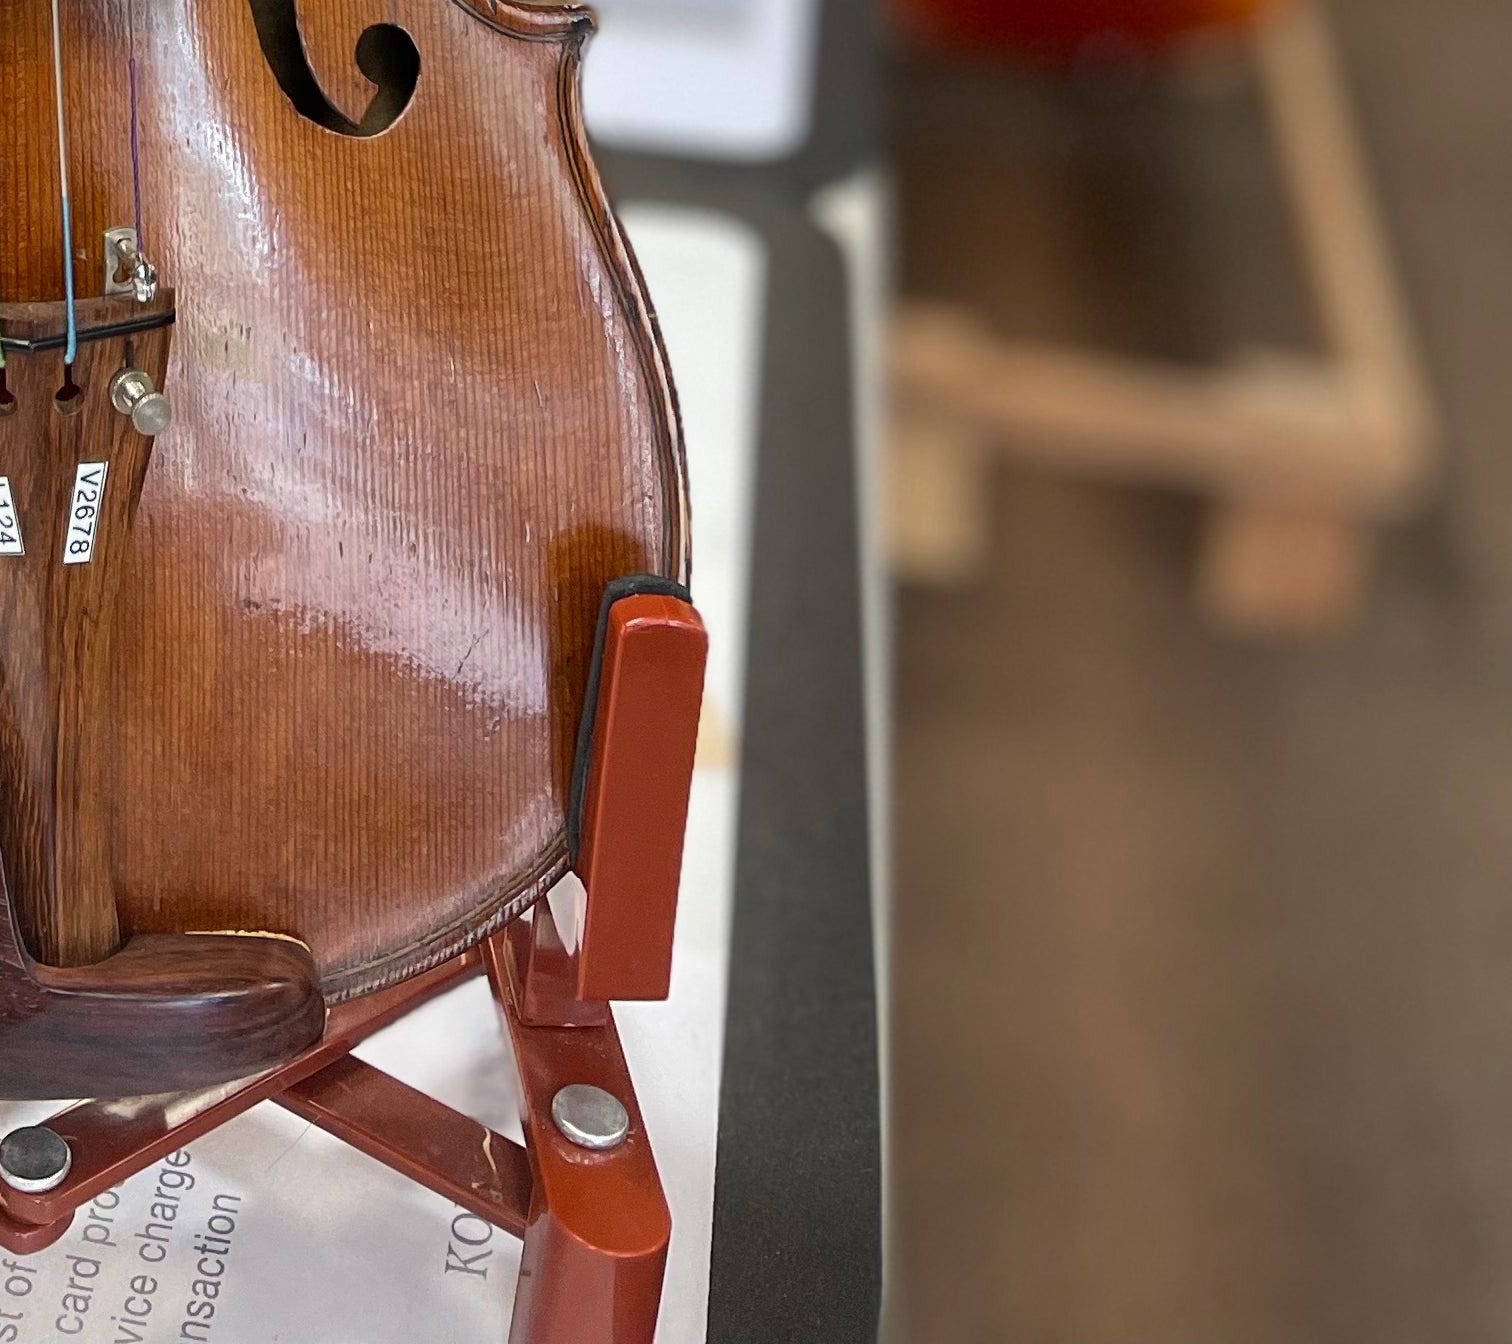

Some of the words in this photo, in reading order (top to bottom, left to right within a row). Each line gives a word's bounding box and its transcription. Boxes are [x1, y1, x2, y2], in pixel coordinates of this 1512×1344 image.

[69, 469, 101, 555] V2678
[134, 1148, 195, 1262] charge
[2, 1258, 37, 1297] of
[55, 1254, 102, 1335] card
